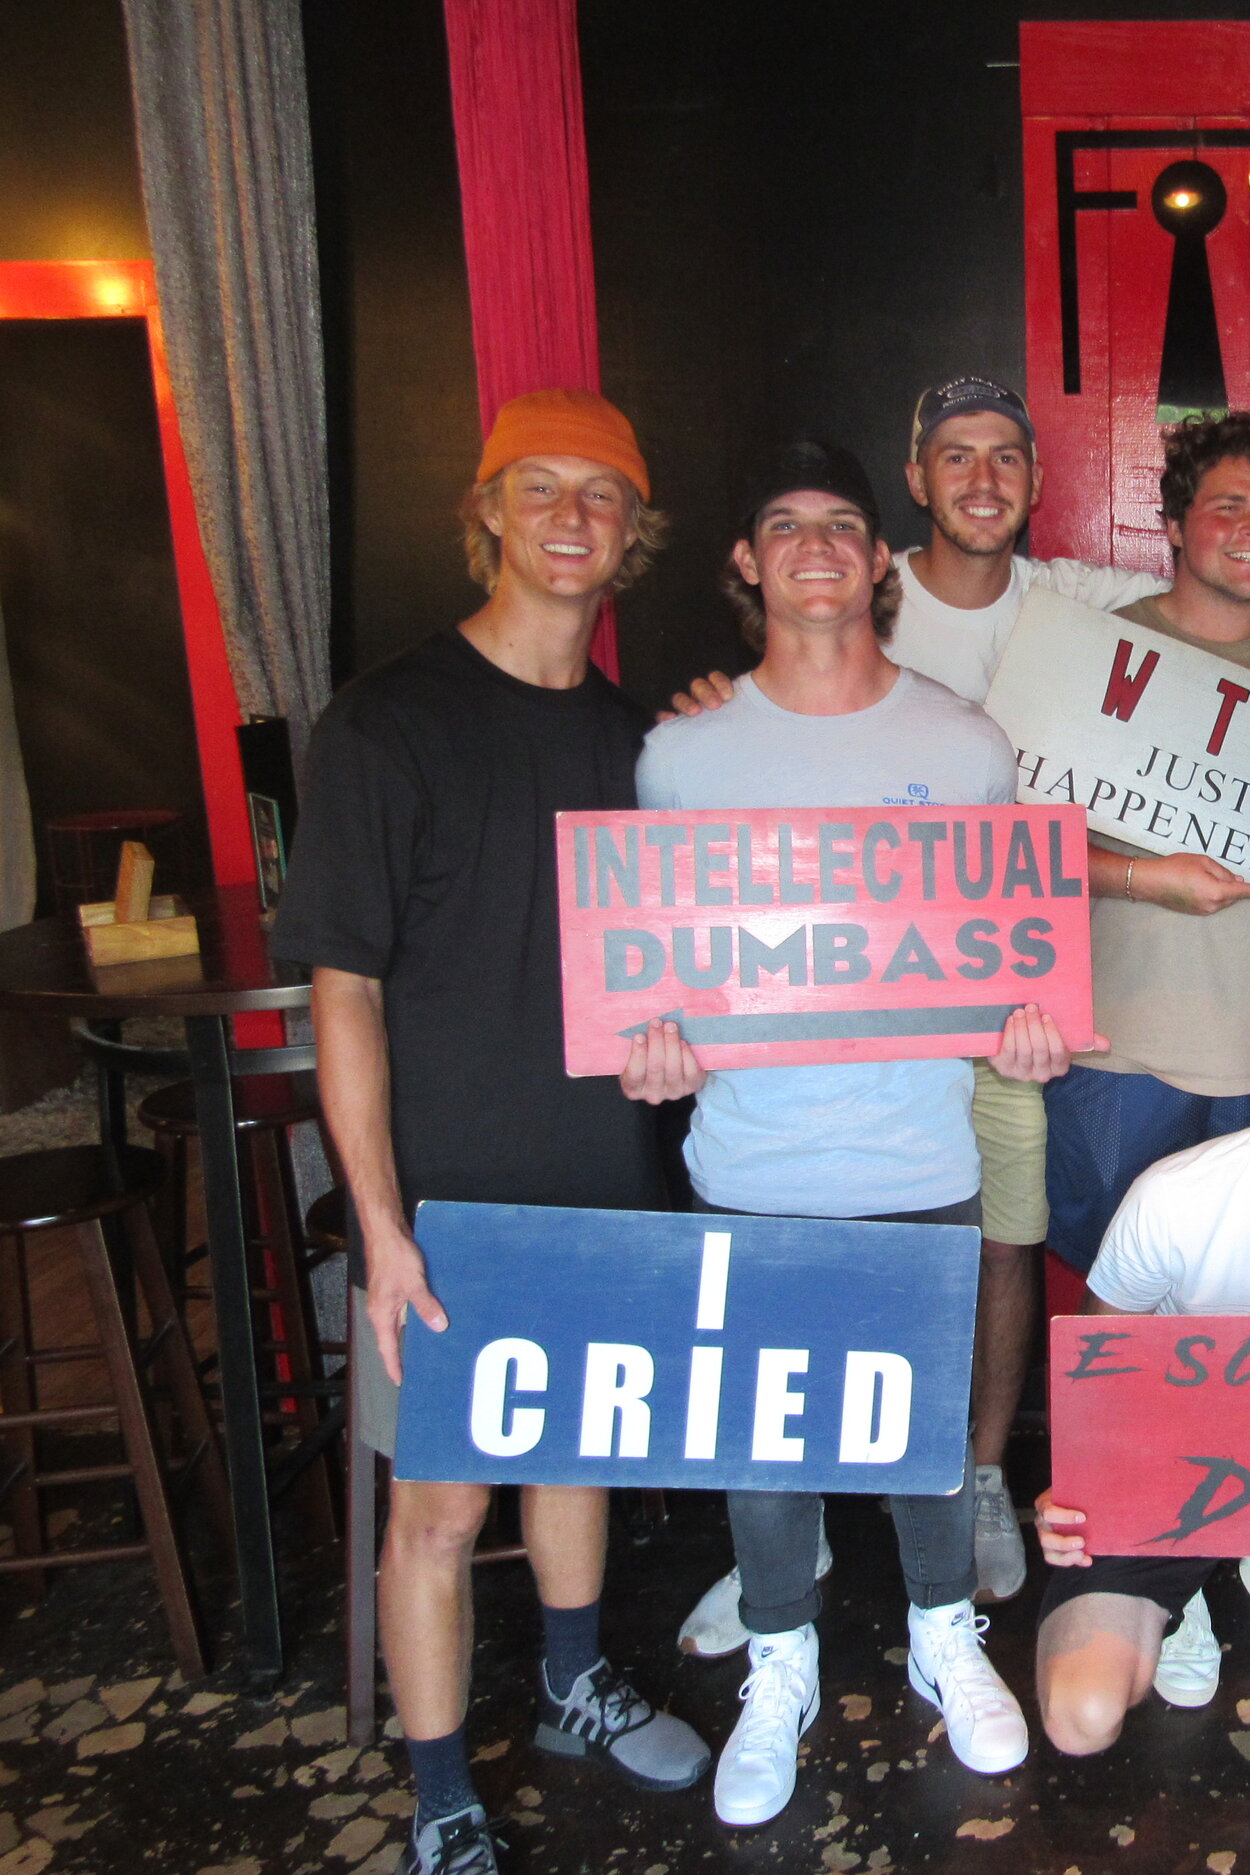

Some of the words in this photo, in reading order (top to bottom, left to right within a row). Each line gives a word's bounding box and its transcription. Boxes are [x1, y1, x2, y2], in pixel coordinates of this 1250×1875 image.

[882, 797, 915, 805] QUIET
[573, 820, 1082, 909] INTELLECTUAL
[602, 917, 1057, 993] DUMBASS
[696, 1231, 732, 1330] I
[470, 1337, 914, 1464] CRIED
